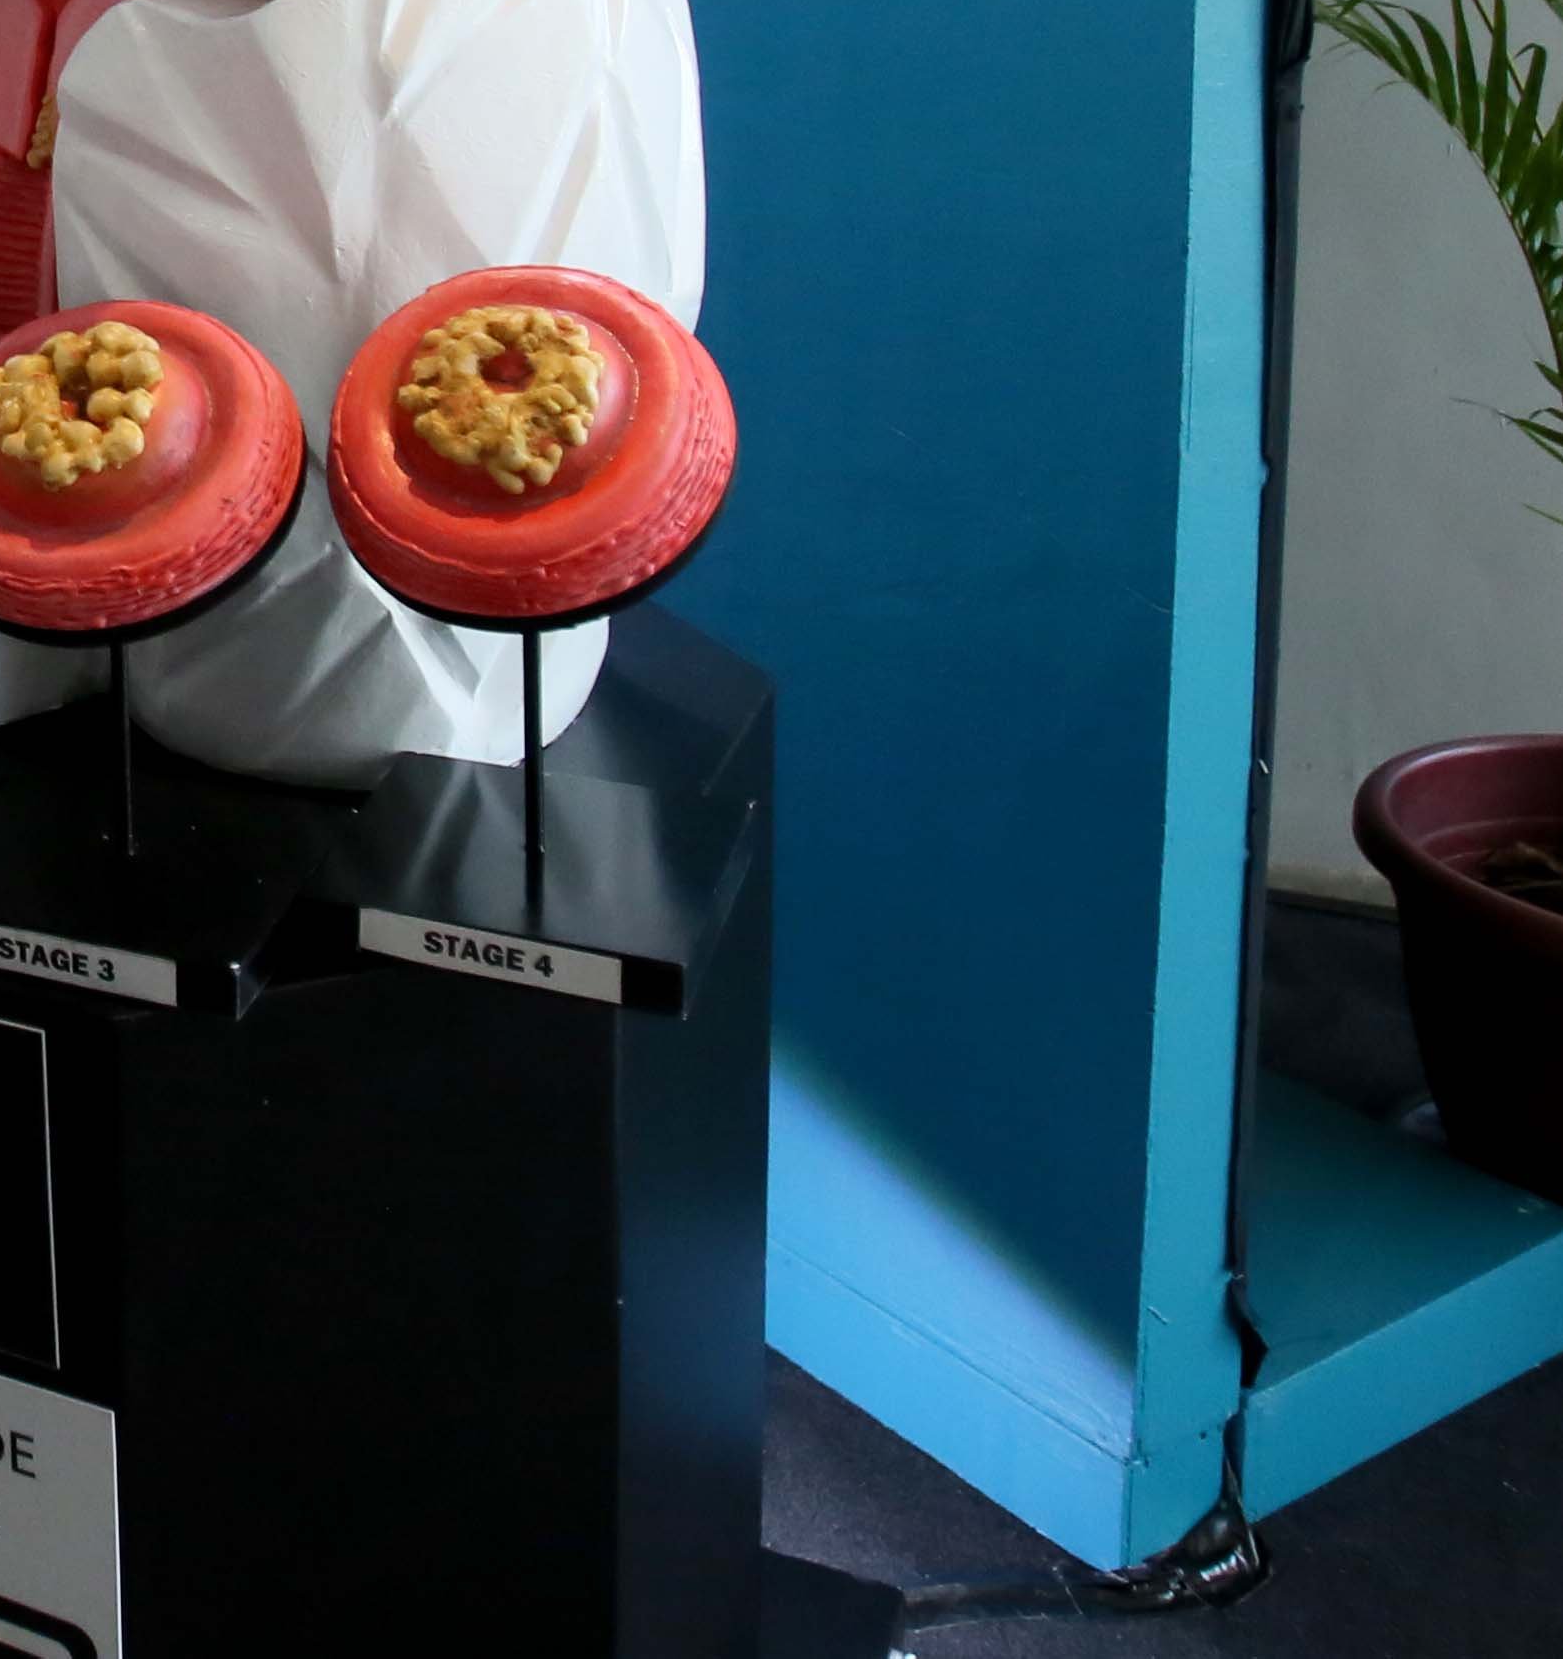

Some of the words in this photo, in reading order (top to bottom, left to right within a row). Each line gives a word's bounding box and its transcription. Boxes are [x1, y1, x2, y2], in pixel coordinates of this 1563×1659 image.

[96, 958, 116, 982] 3
[423, 930, 526, 973] STAGE
[533, 954, 554, 978] 4
